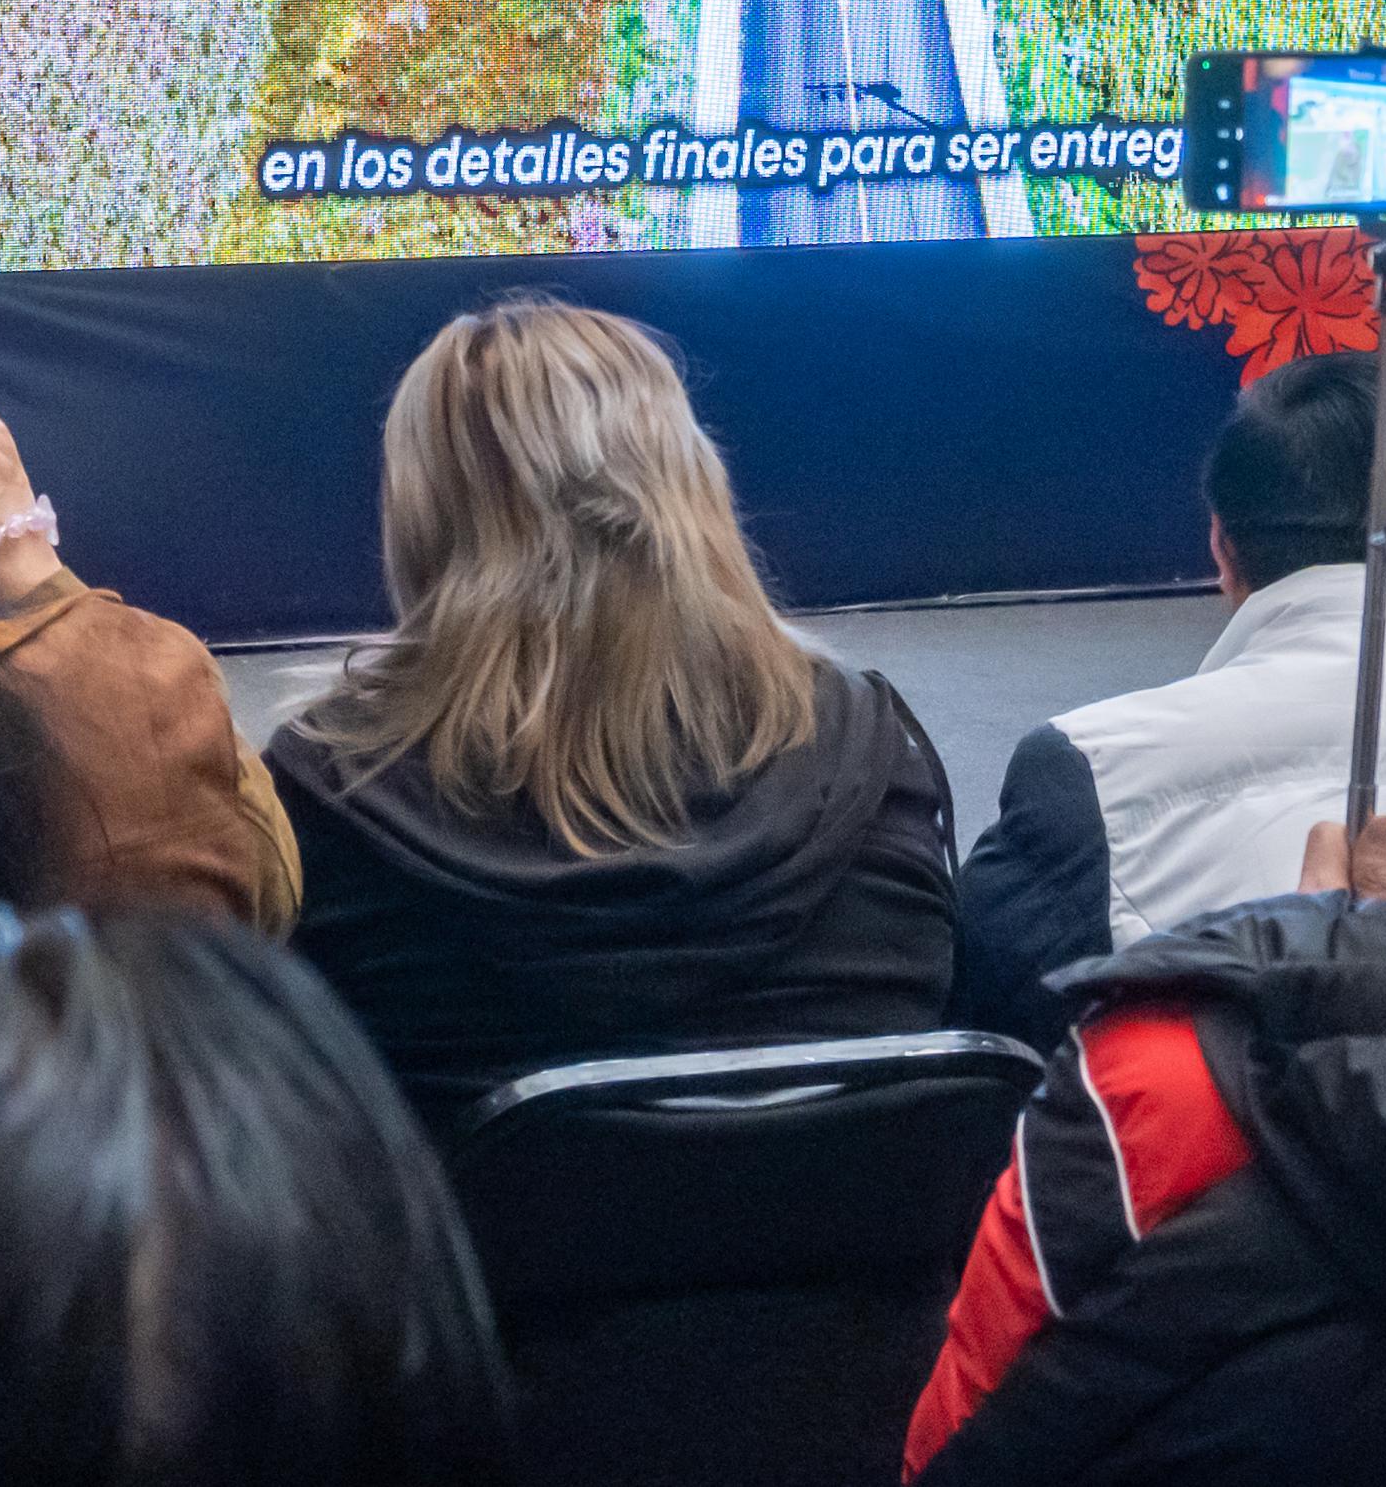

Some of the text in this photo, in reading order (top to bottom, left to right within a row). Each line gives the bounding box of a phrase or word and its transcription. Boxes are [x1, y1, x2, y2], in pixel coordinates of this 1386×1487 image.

[265, 143, 325, 192] en
[339, 136, 412, 189] los
[424, 131, 630, 188] detalles
[642, 127, 807, 184] finales
[817, 134, 934, 189] para
[944, 132, 1021, 174] ser
